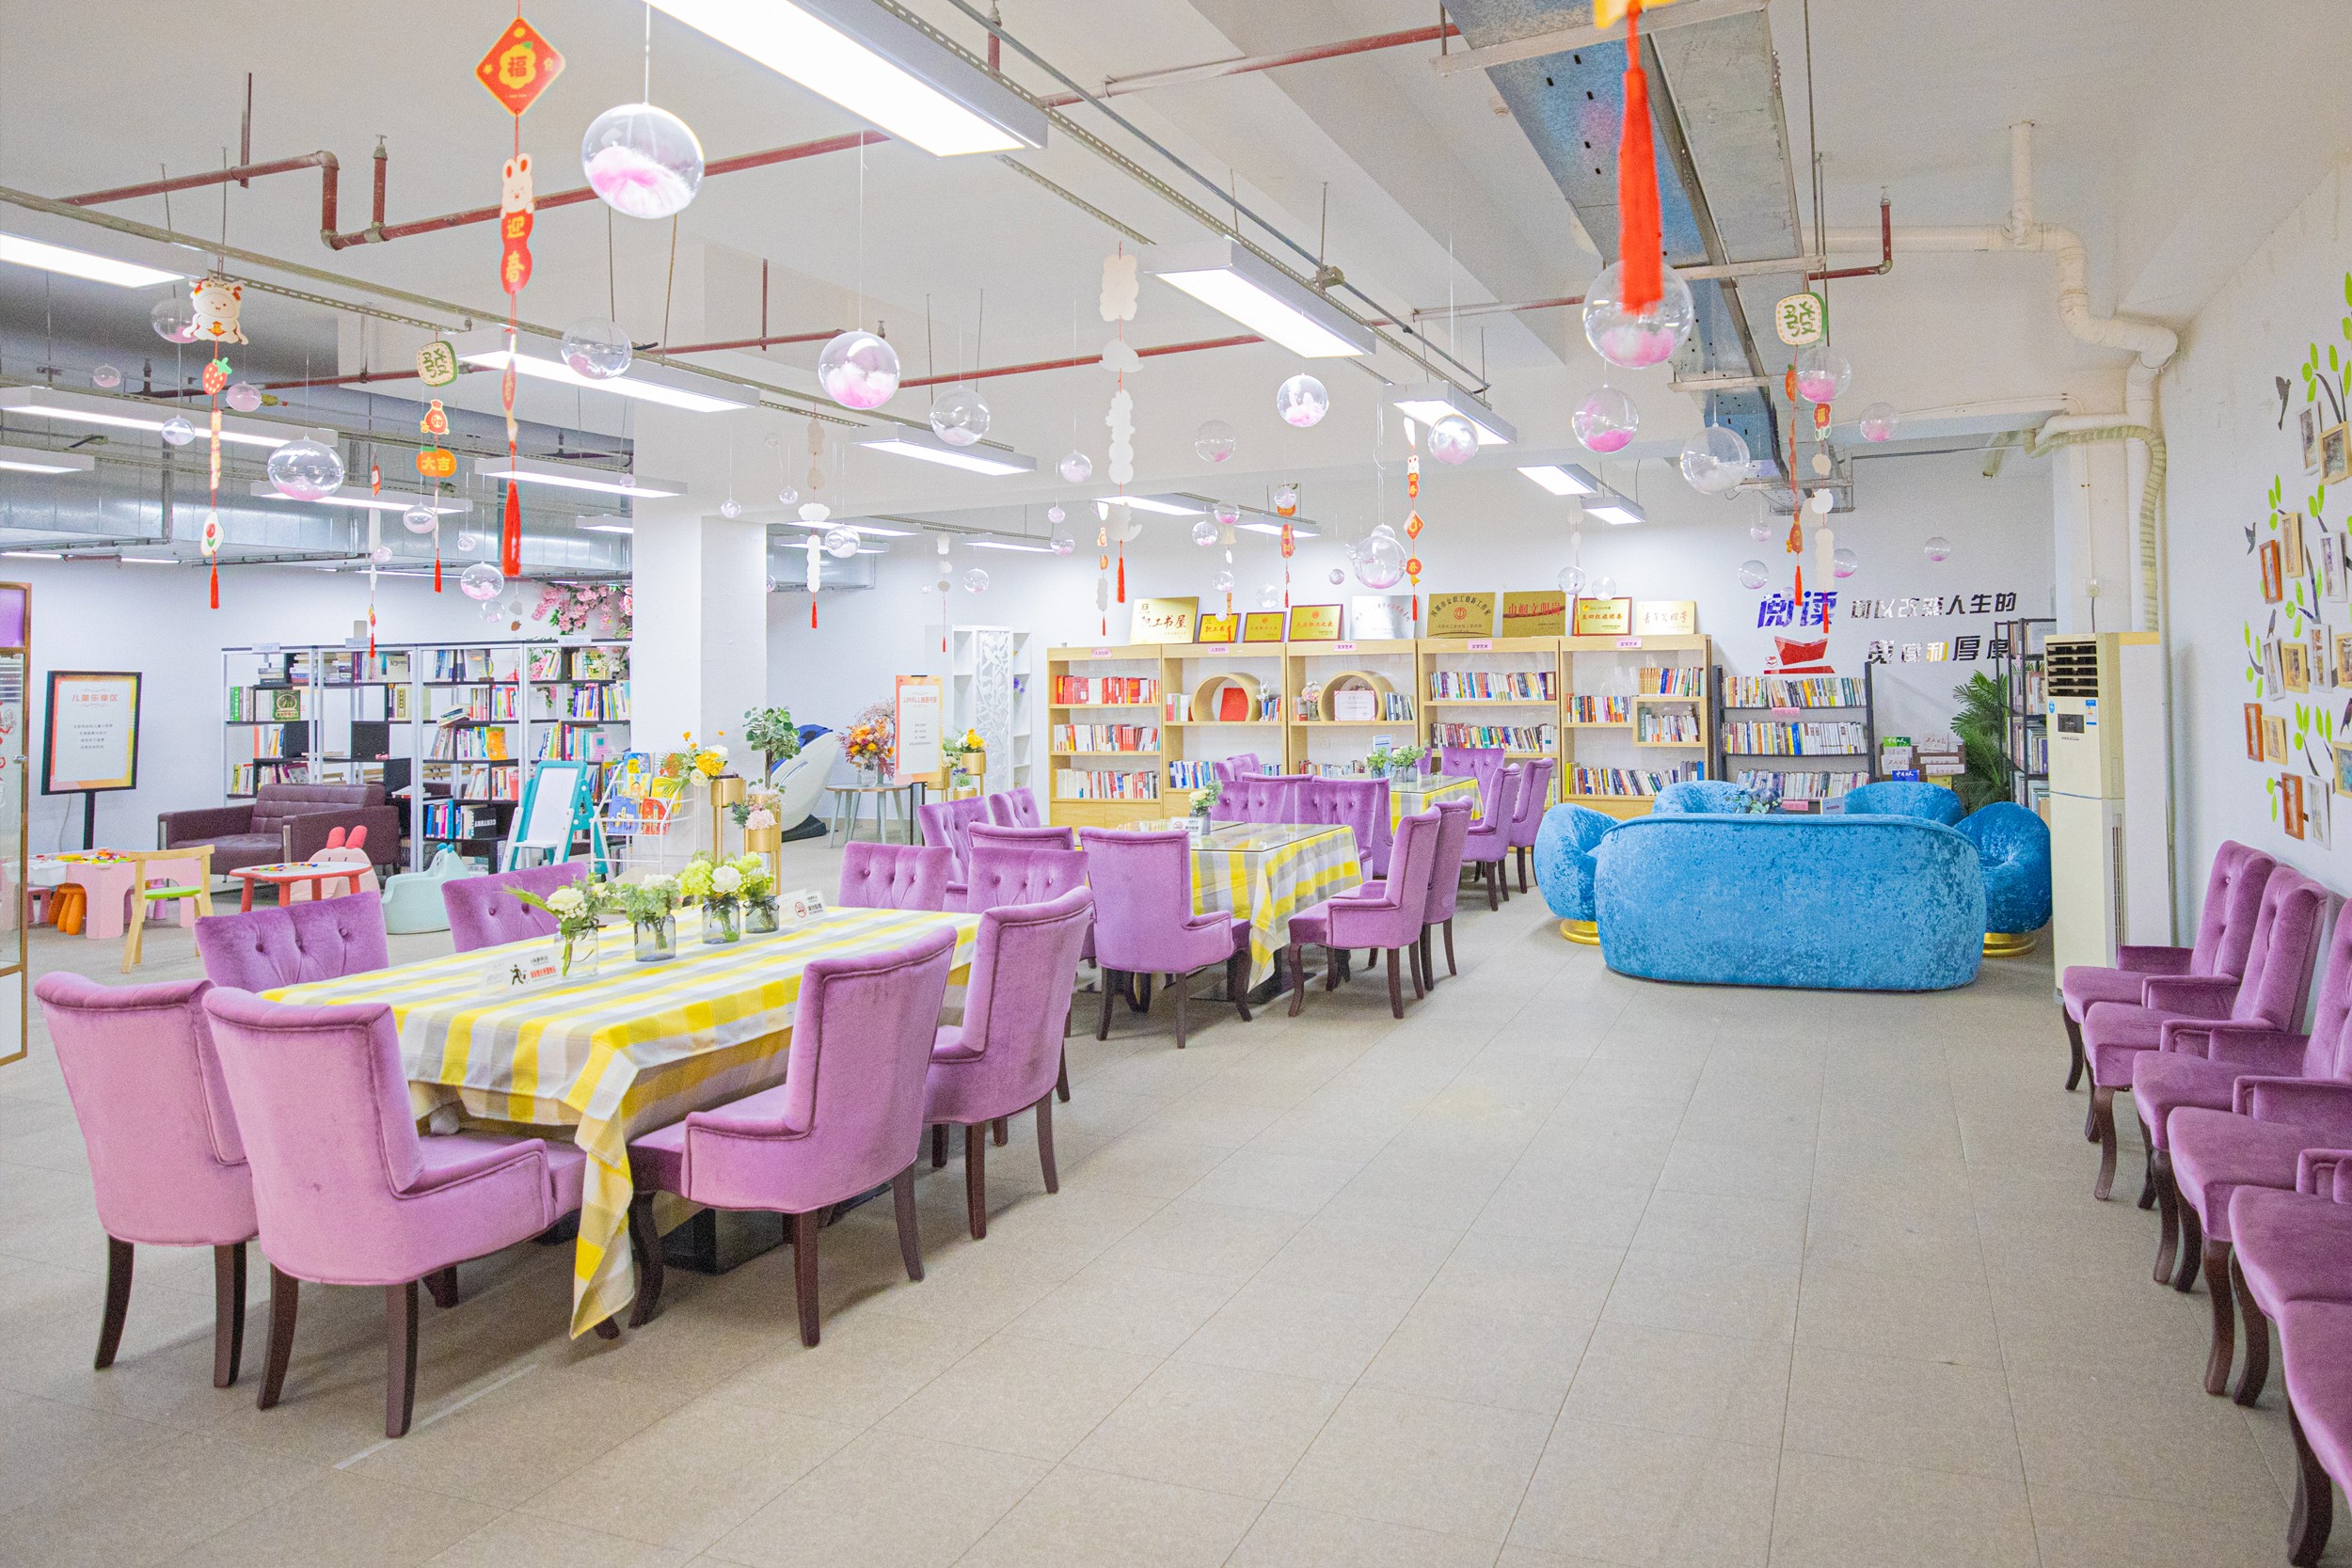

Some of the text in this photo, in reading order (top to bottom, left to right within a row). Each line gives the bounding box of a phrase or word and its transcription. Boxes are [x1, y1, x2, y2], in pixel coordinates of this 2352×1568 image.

[507, 55, 527, 77] 福
[505, 215, 526, 283] 迎春
[421, 457, 451, 470] 大吉
[1508, 602, 1561, 617] 巾帼文明岗
[1757, 592, 2017, 628] 阅读 可以改变人生的
[1867, 636, 2010, 665] 宽度和厚度
[474, 818, 497, 828] CENTURY
